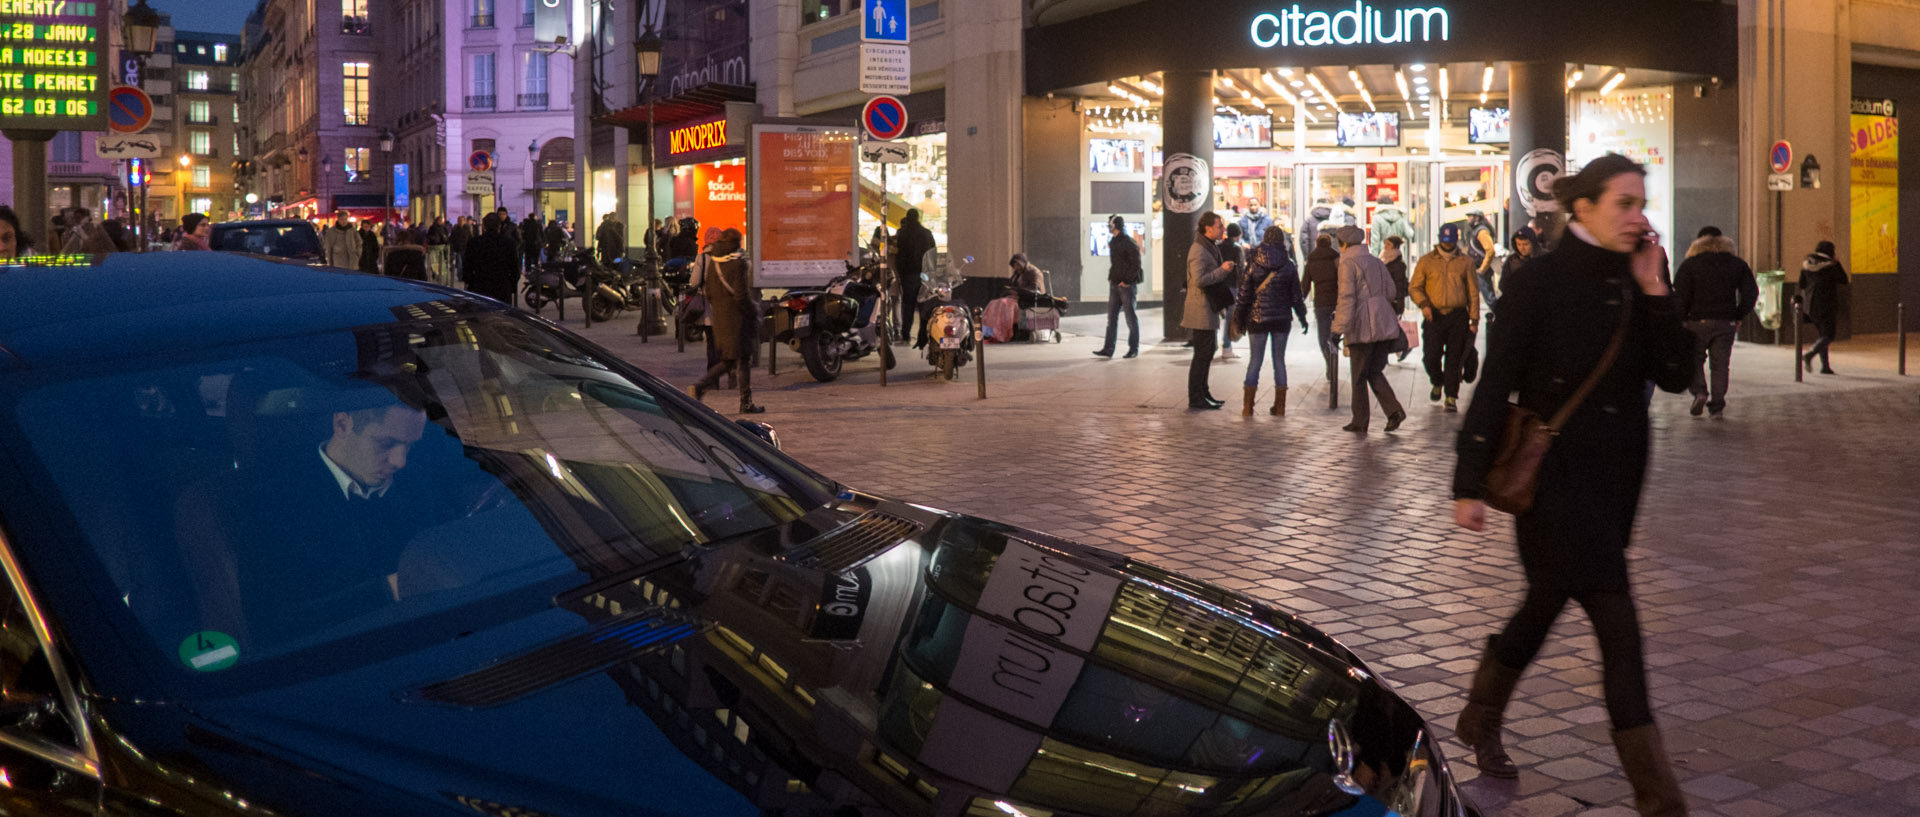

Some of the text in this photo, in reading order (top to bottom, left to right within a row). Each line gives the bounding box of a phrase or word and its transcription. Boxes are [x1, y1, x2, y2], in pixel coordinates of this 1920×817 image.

[1251, 0, 1449, 48] citadium
[44, 25, 95, 42] JANV.
[34, 73, 97, 92] PERRET
[2, 98, 88, 116] 62 03 06
[670, 120, 726, 155] MONOPRIX
[708, 179, 735, 191] food
